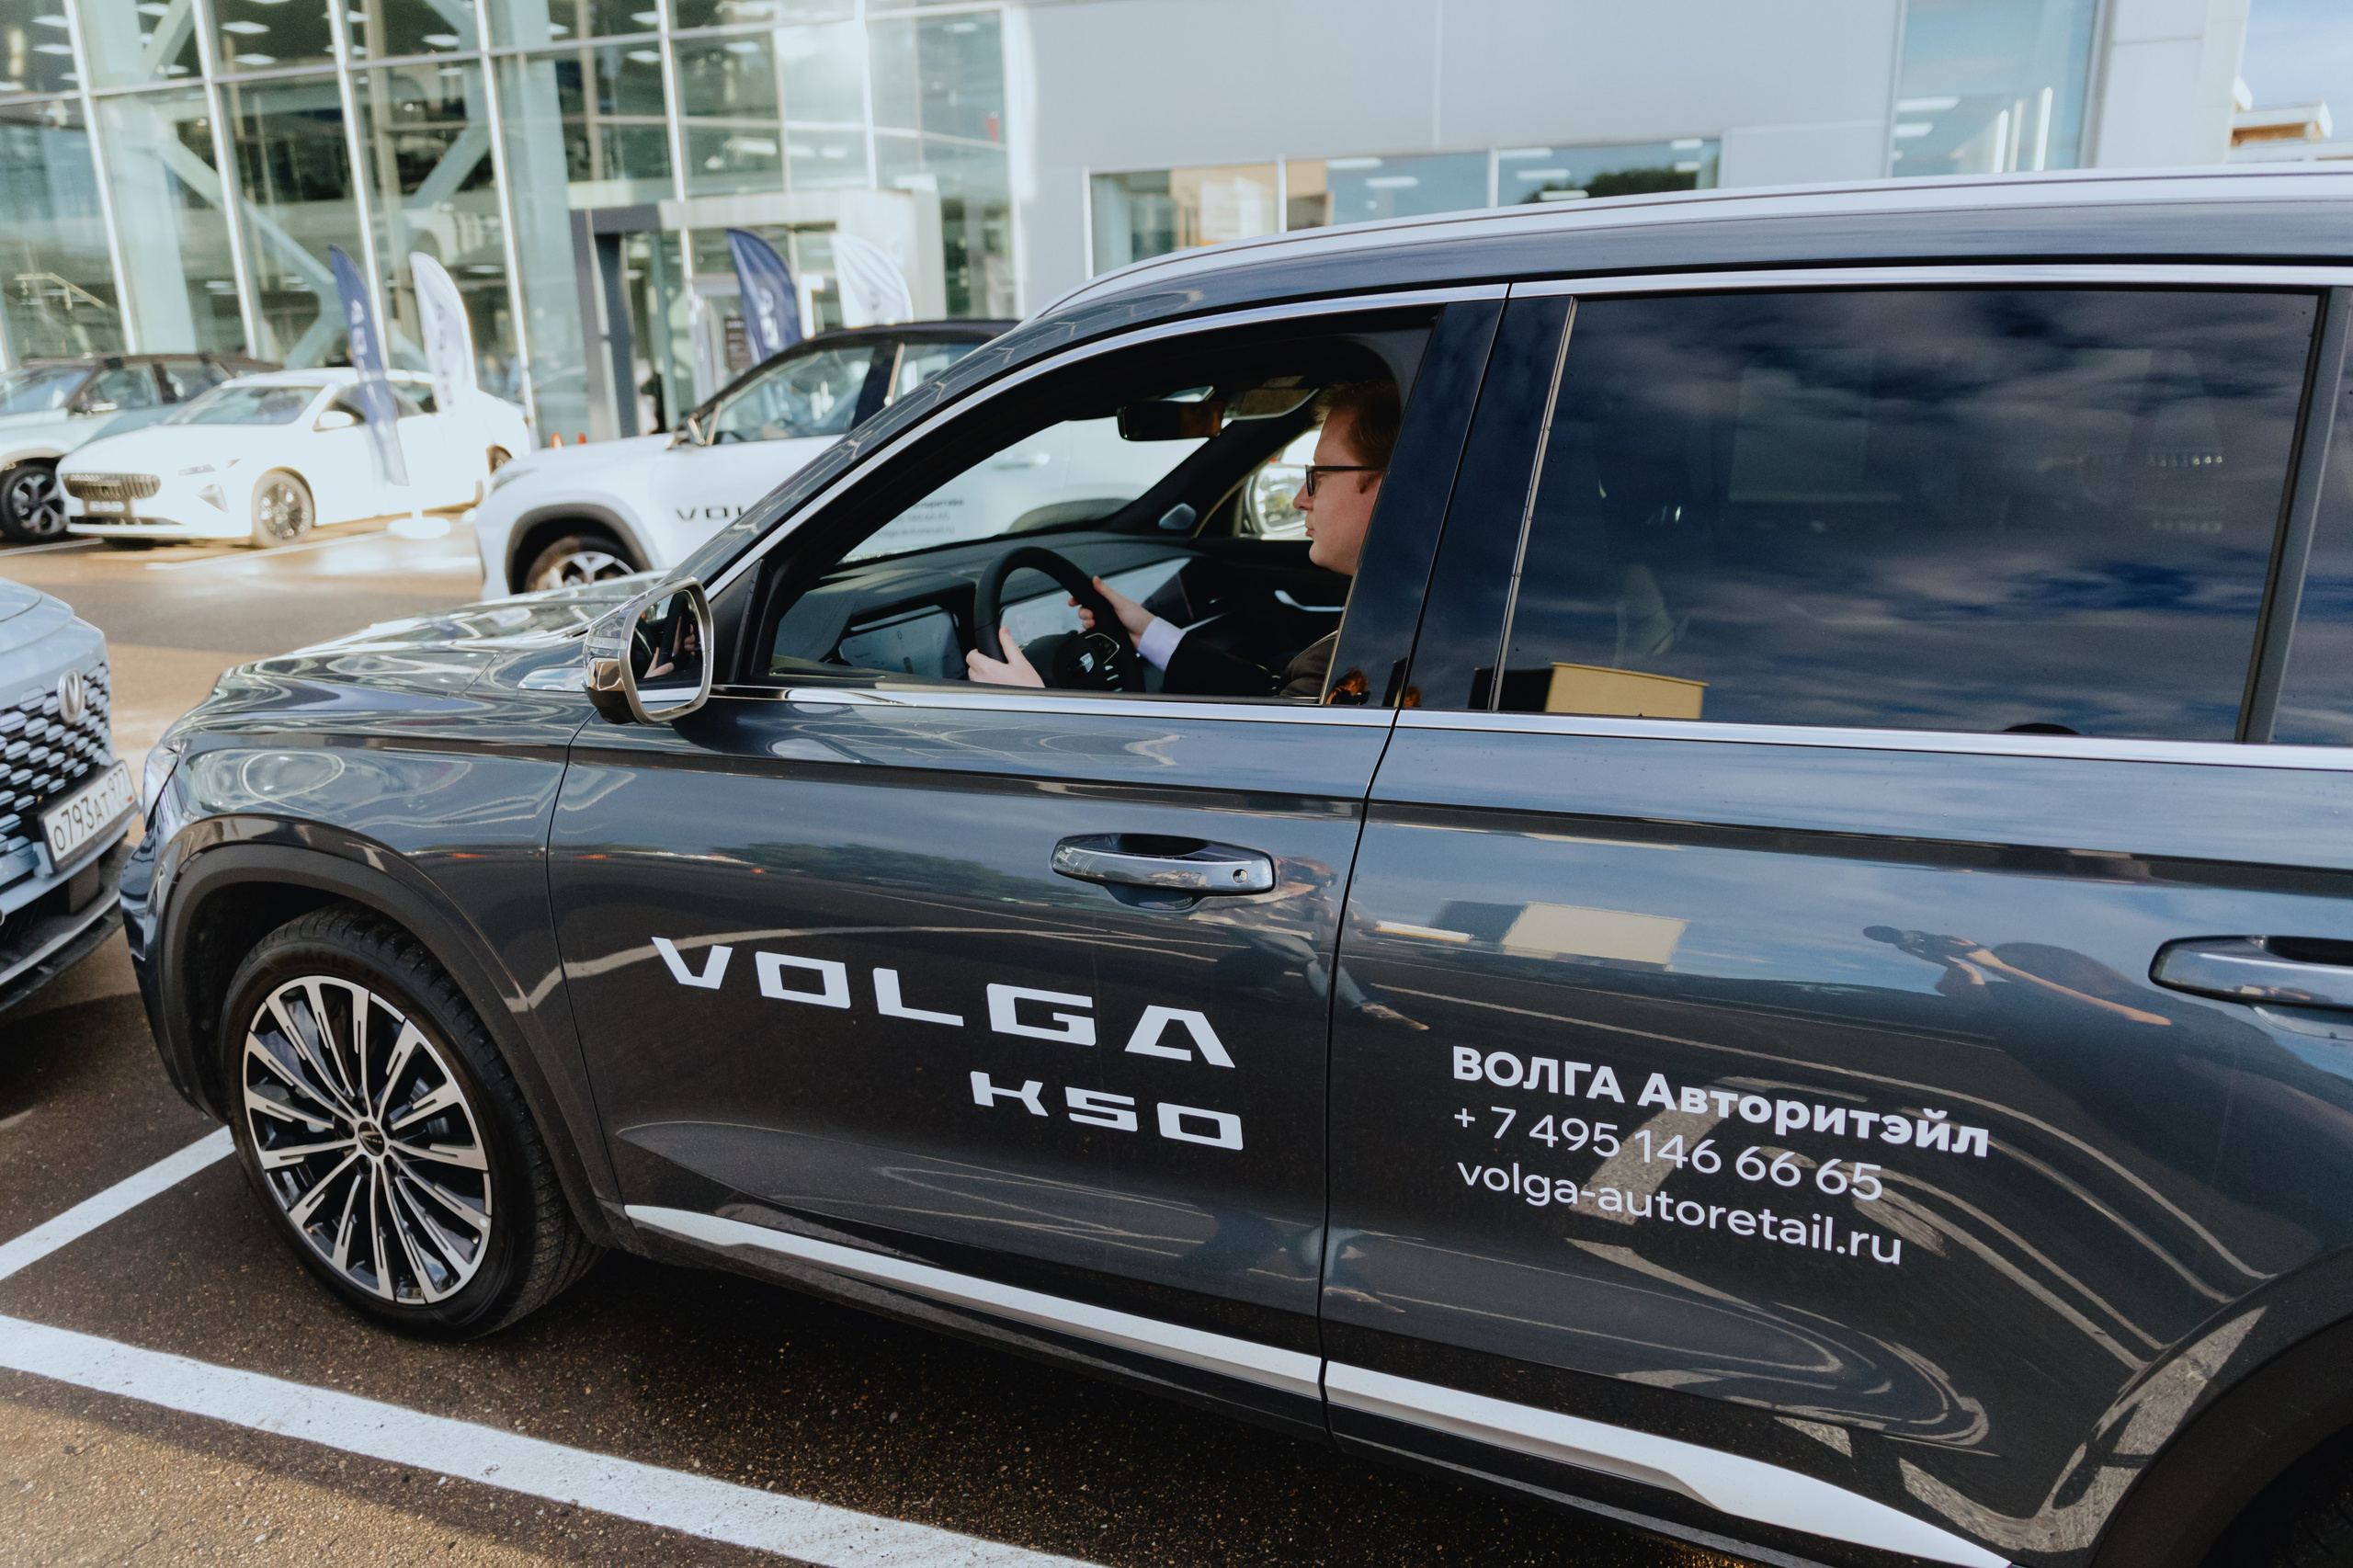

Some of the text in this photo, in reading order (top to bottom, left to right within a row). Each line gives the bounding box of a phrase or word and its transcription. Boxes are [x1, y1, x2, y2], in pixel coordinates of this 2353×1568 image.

[652, 937, 1235, 1068] VOLGA
[970, 1071, 1243, 1151] K50
[1453, 1046, 1989, 1158] ВОЛГА Авторитэйл
[1454, 1107, 1882, 1201] + 7 495 146 66 65
[1457, 1162, 1901, 1265] volga-autoretail.ru
